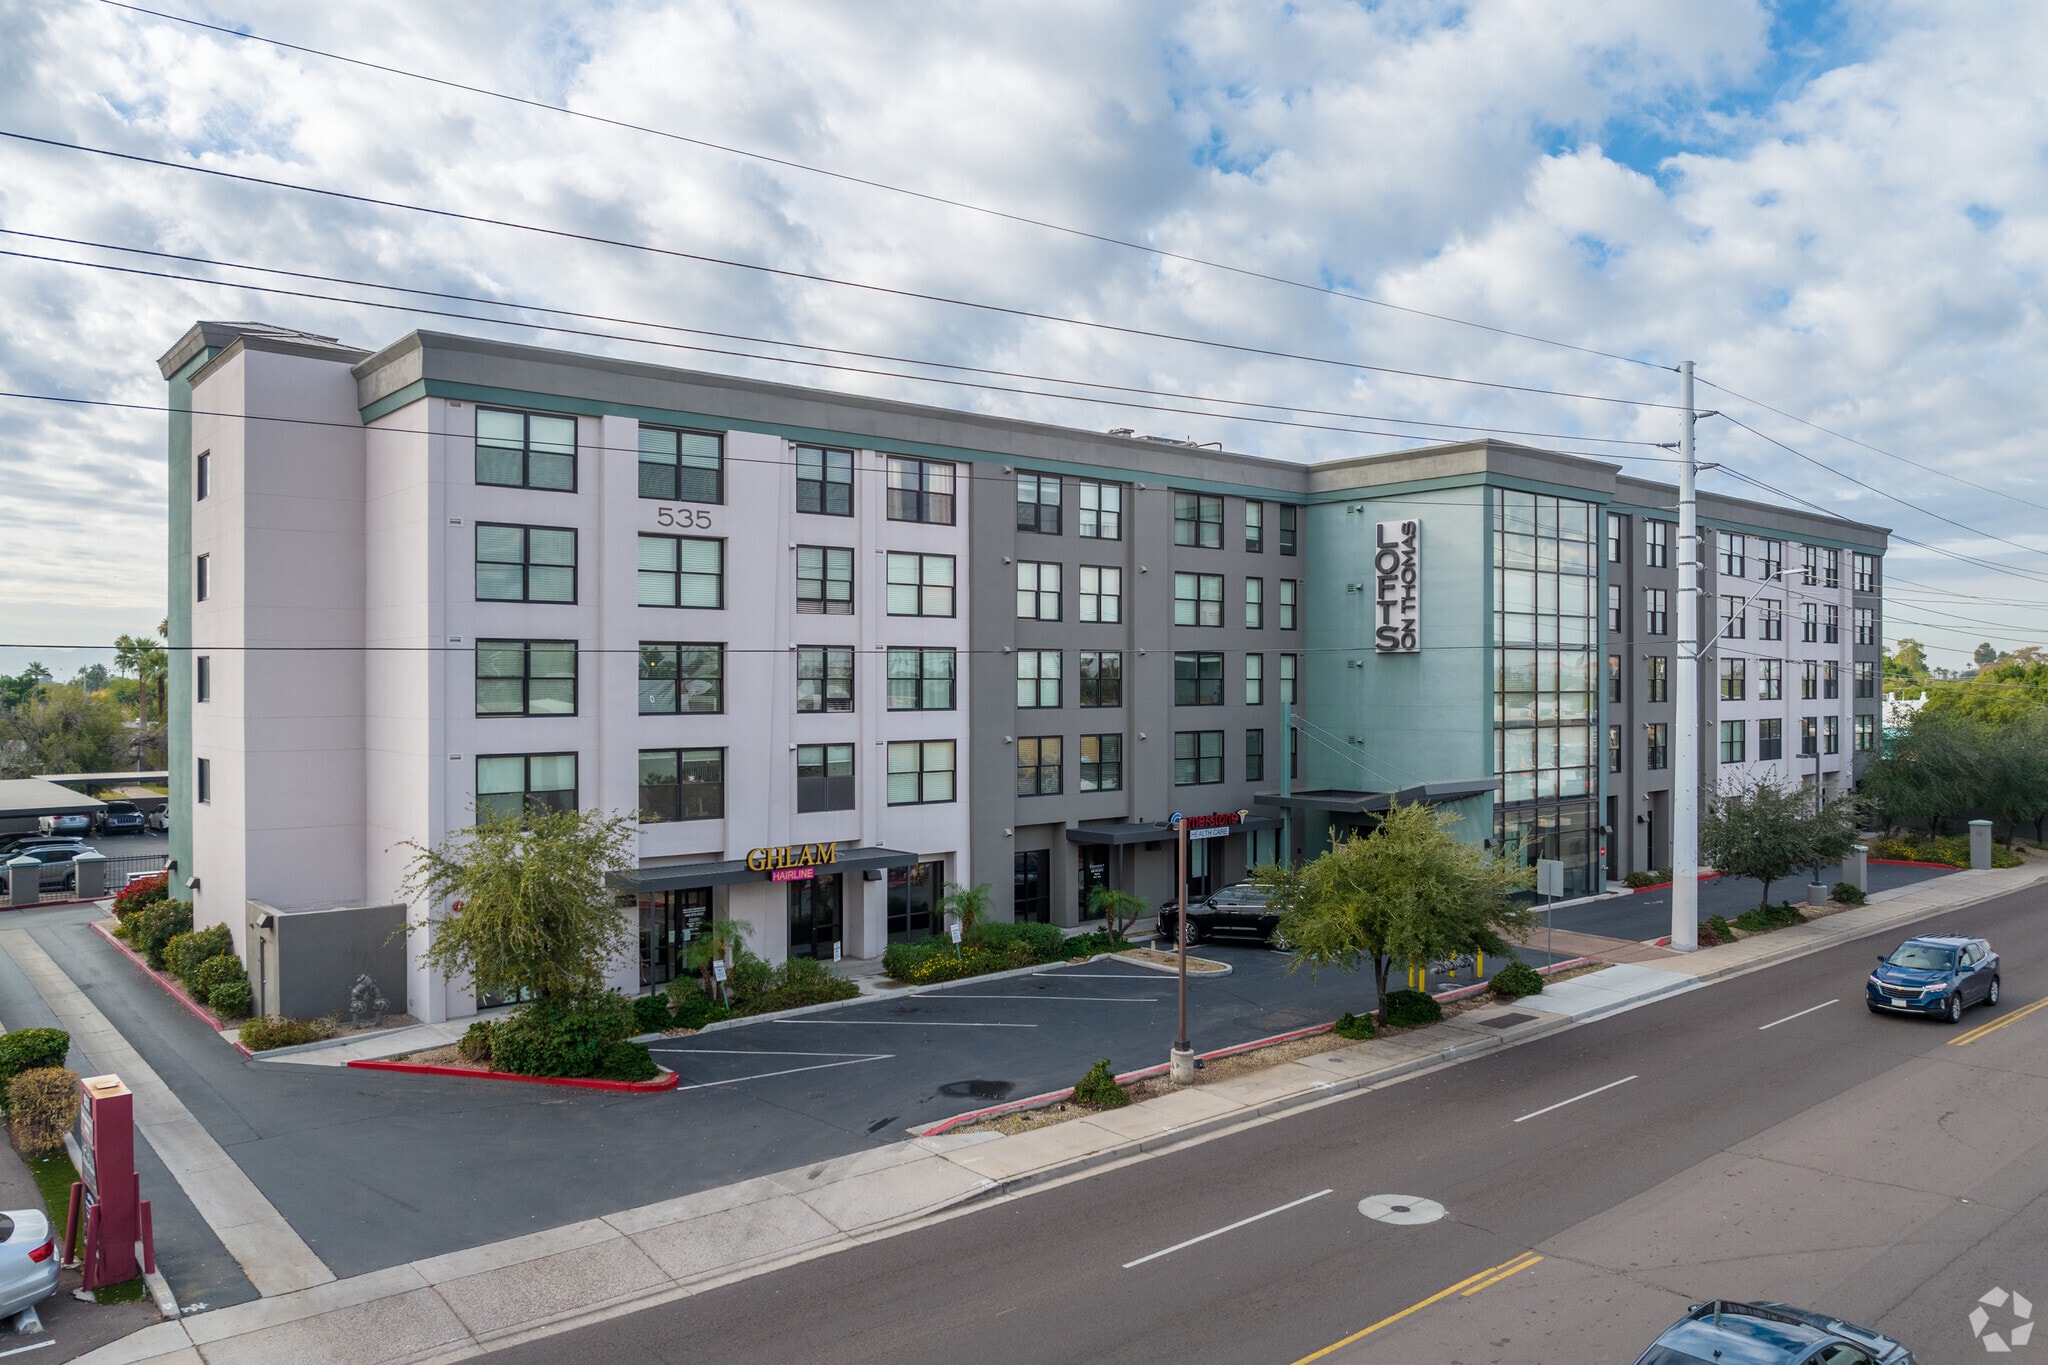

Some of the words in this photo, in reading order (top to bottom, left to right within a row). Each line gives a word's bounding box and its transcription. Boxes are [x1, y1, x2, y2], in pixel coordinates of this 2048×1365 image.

[657, 507, 712, 529] 535
[1401, 521, 1416, 614] THOMAS
[1375, 524, 1400, 651] LOFTS
[1401, 619, 1416, 650] ON
[1191, 829, 1213, 838] HEALTH
[1213, 827, 1228, 836] CARE
[746, 842, 838, 871] GHLAM
[772, 869, 814, 881] HAIRLINE
